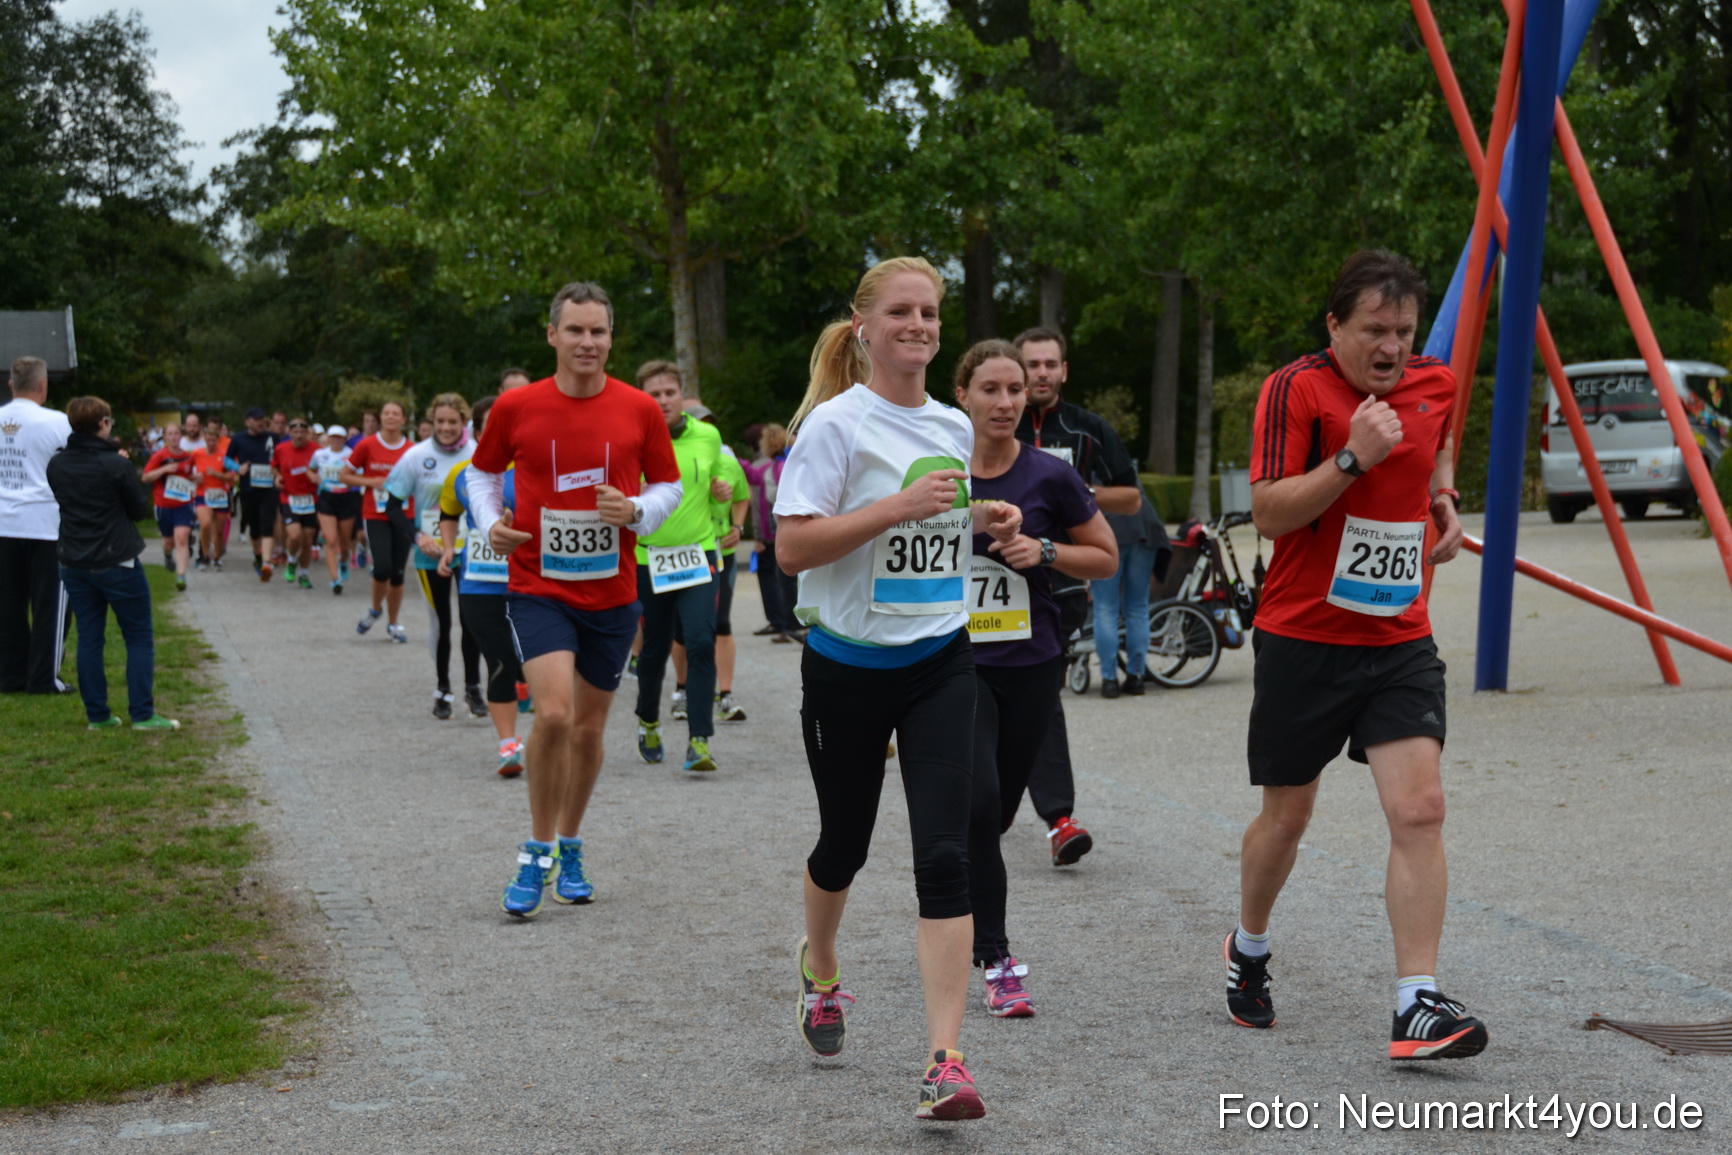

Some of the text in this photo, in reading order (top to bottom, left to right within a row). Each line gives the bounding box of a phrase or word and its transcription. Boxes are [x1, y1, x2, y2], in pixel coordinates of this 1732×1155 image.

[0, 448, 27, 457] UFTRAG
[916, 519, 959, 529] Neumarkt
[1346, 525, 1417, 541] PARTL Neumarkt
[549, 526, 613, 553] 3333
[655, 550, 701, 572] 2106
[886, 534, 961, 573] 3021
[1347, 542, 1418, 580] 2363
[1370, 588, 1392, 603] Jan
